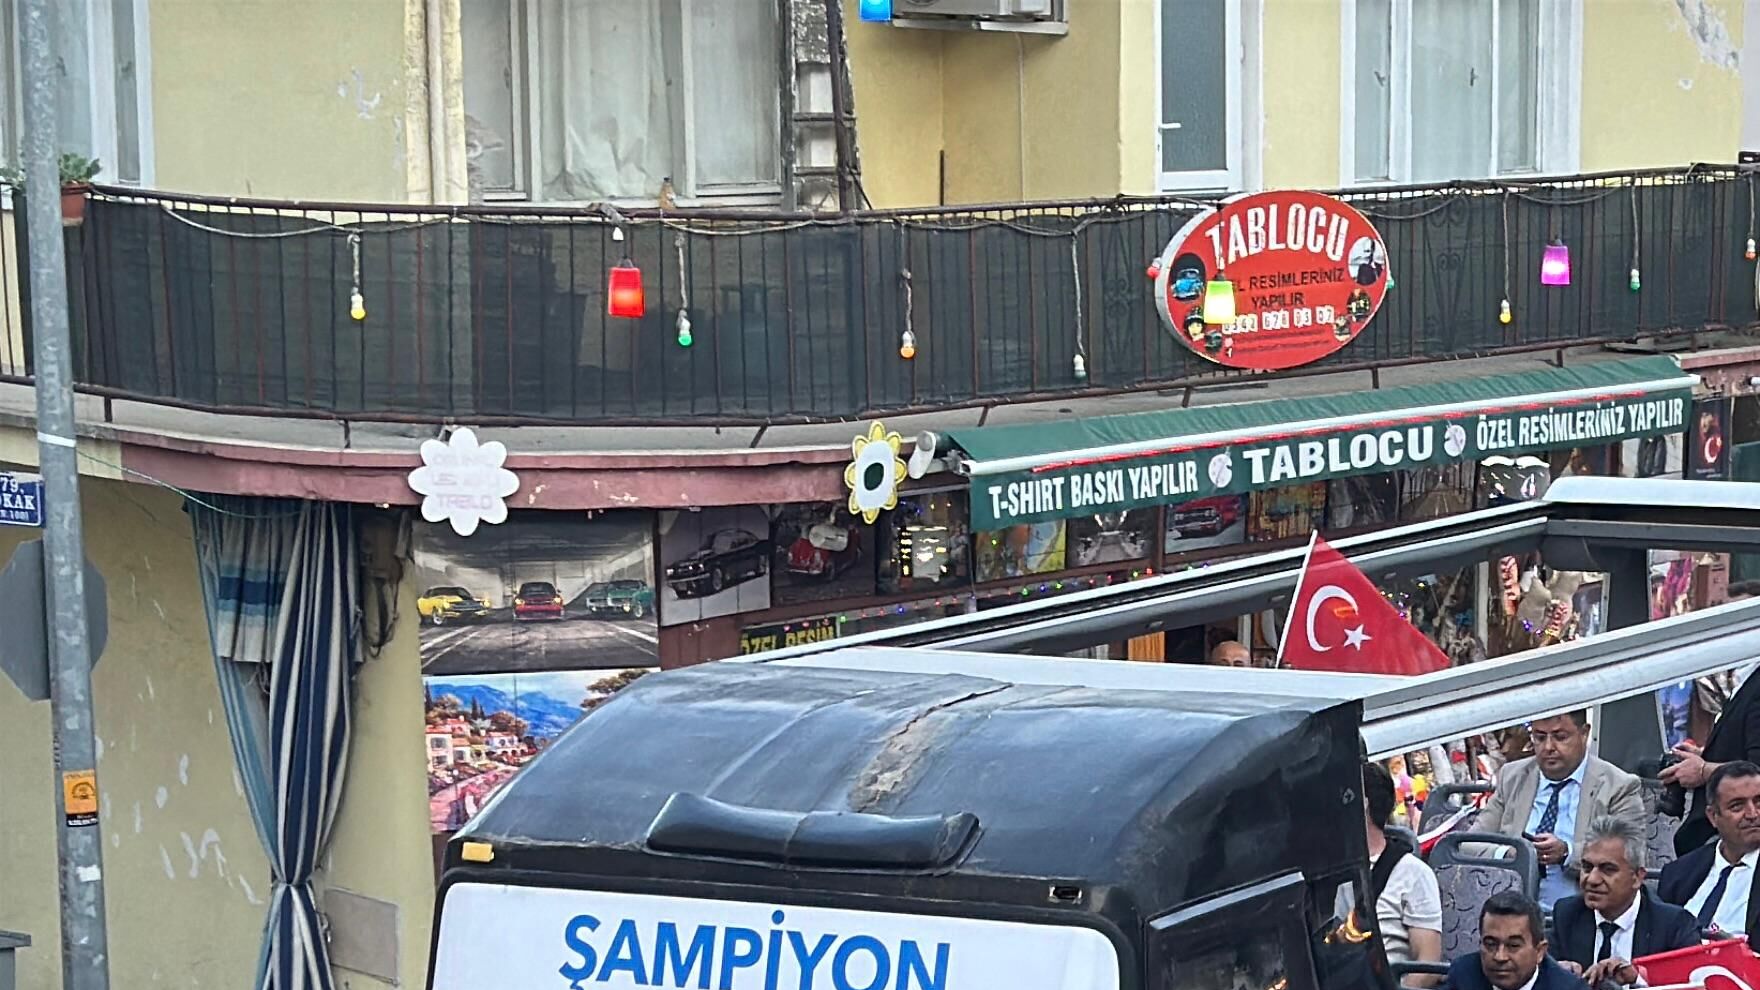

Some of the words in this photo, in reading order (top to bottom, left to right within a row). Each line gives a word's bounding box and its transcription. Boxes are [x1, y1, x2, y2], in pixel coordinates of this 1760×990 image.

[1205, 203, 1349, 268] TABLOCU
[1249, 267, 1344, 291] RESİMLERİNİZ
[1251, 292, 1305, 309] YAPILIR
[988, 476, 1066, 519] T-SHIRT
[1070, 470, 1125, 506] BASKI
[1127, 460, 1199, 500] YAPILIR
[1243, 425, 1434, 485] TABLOCU
[1476, 413, 1516, 451] ÖZEL
[1518, 401, 1626, 447] RESİMLERİNİZ
[1627, 397, 1684, 433] YAPILIR
[0, 493, 35, 510] KAK
